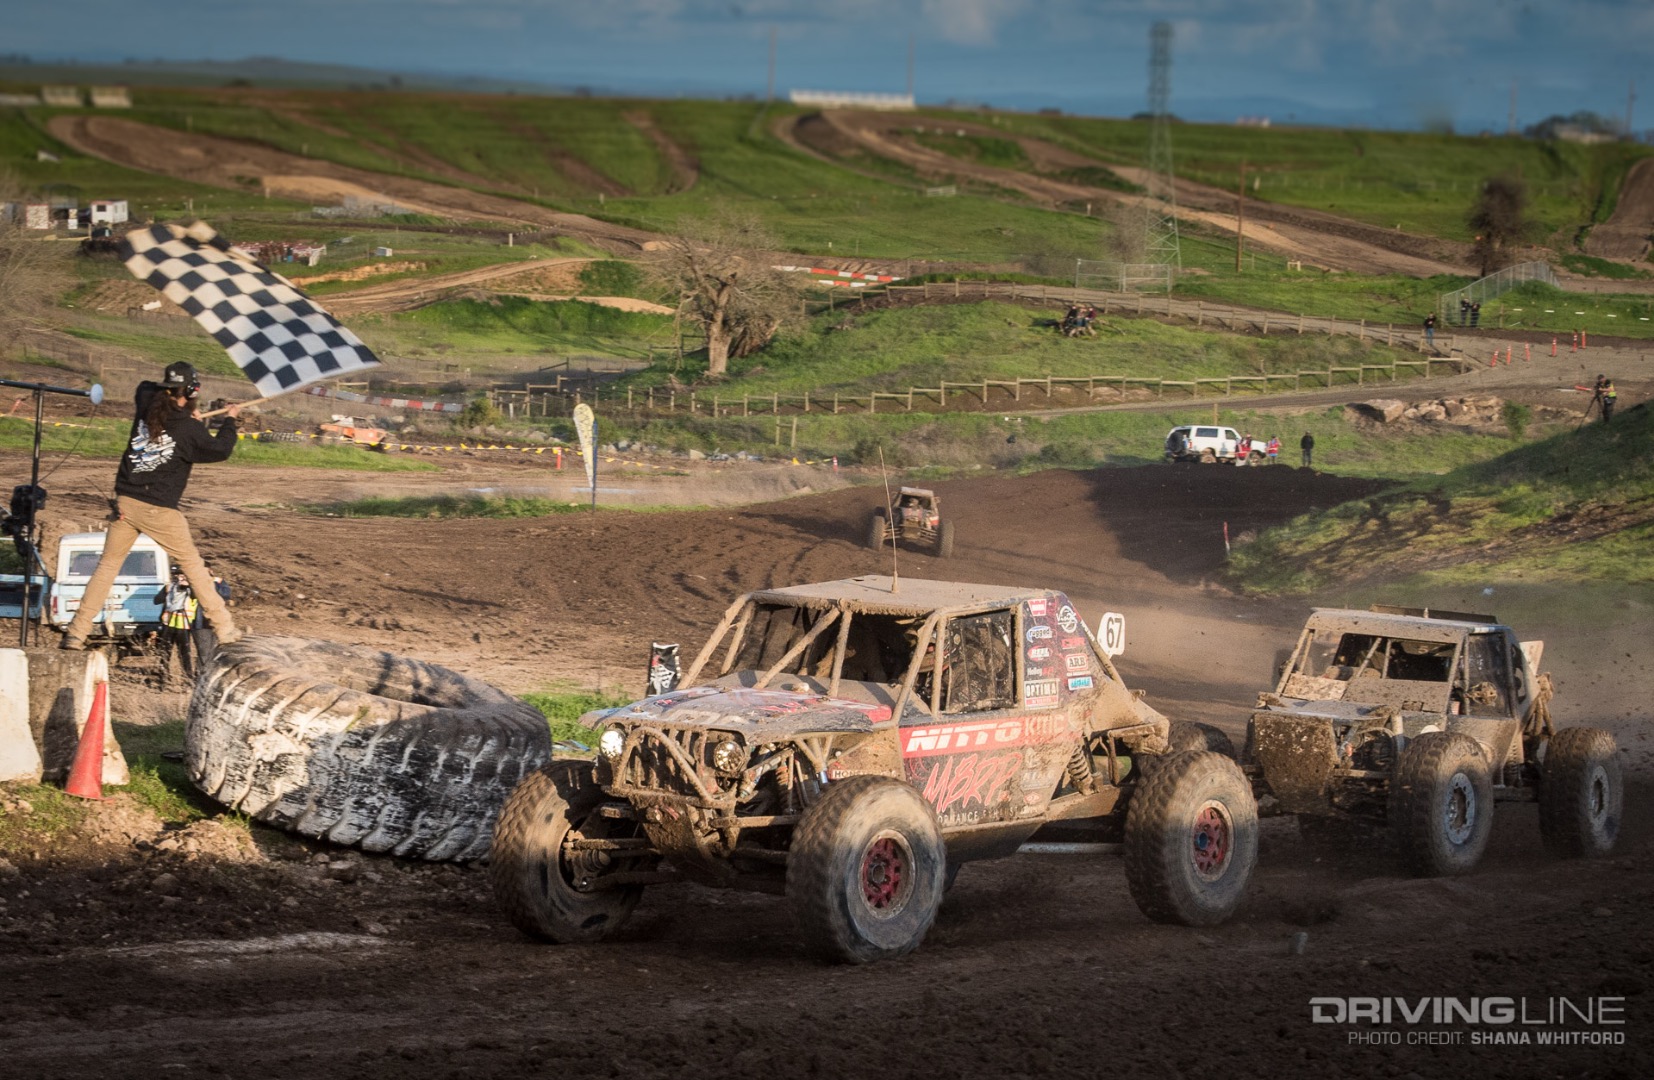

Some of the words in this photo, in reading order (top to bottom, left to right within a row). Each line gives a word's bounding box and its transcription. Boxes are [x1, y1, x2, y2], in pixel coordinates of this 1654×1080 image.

[1106, 616, 1123, 649] 67
[1025, 682, 1057, 698] OPTIMA
[906, 721, 1023, 752] NITTO
[923, 752, 1023, 814] MBRP
